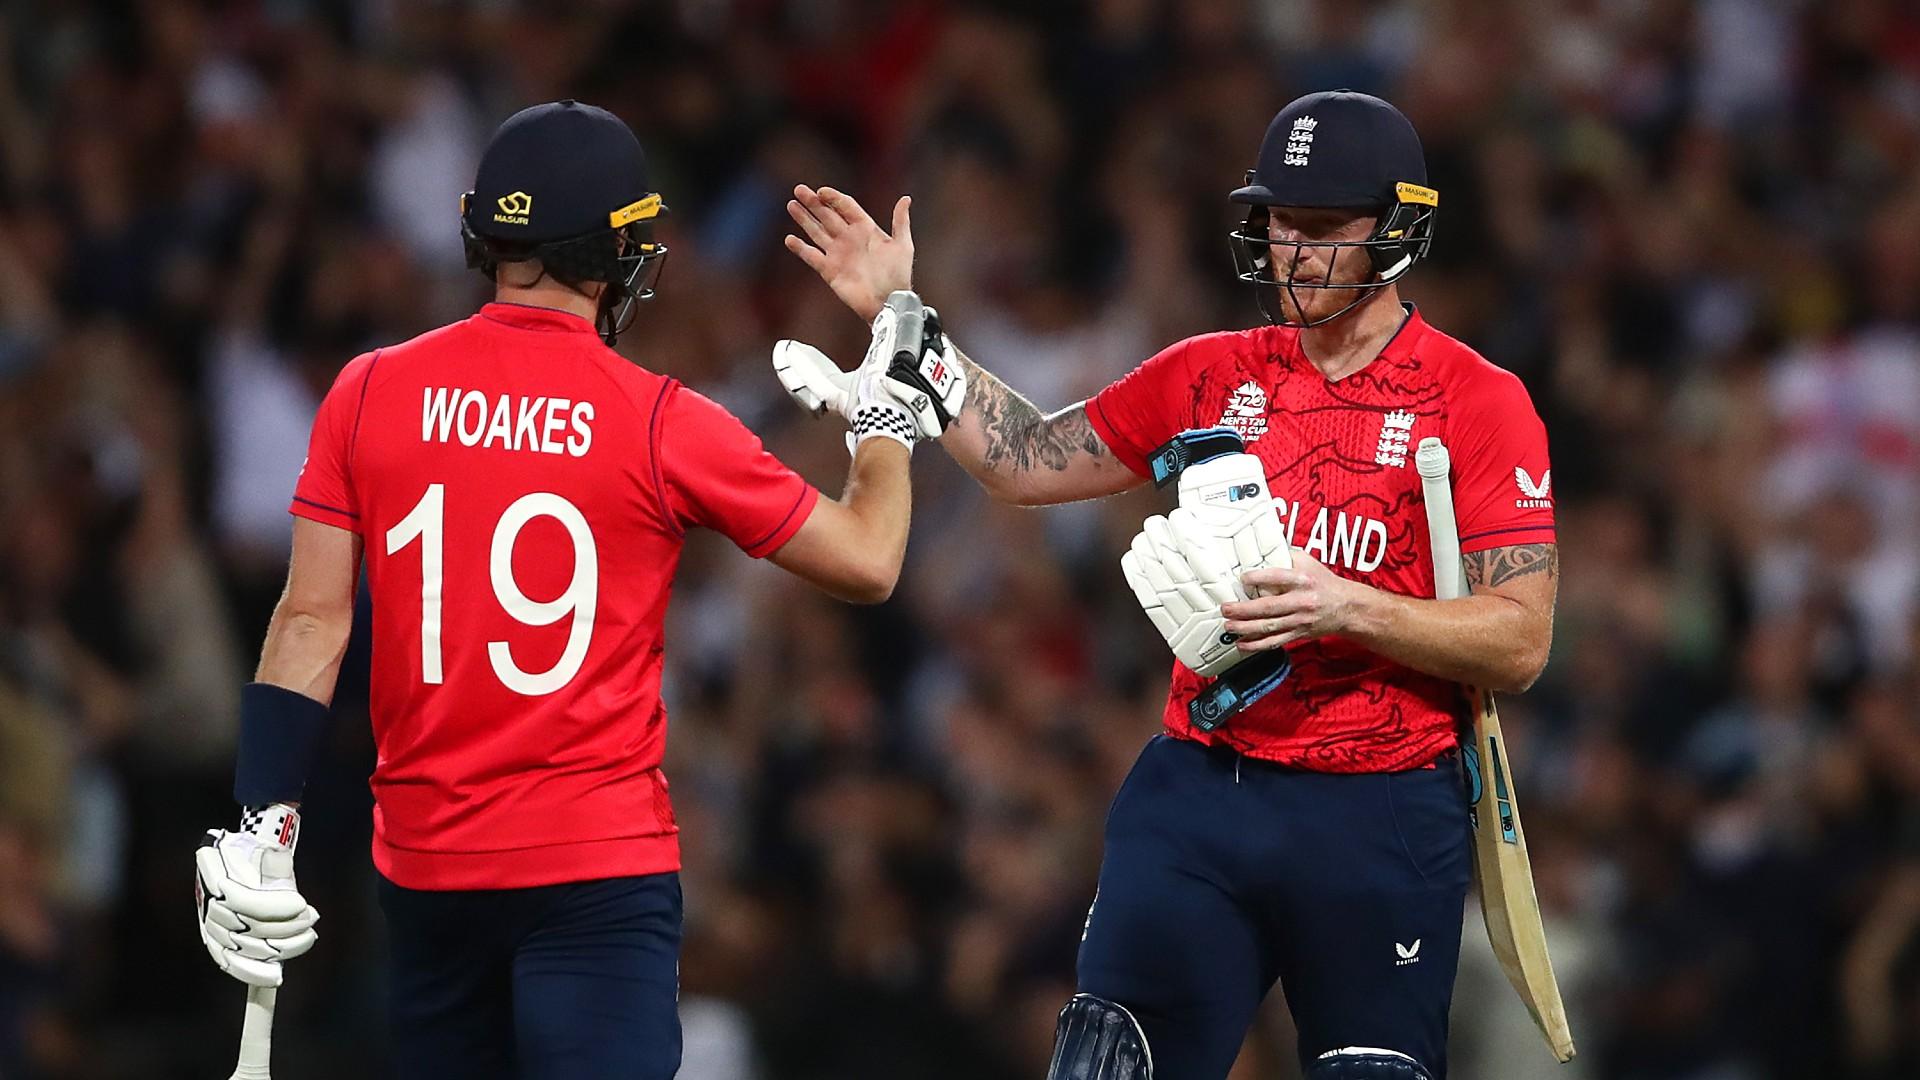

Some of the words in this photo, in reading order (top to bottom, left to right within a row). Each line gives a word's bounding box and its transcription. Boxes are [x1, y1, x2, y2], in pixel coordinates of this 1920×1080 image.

[493, 213, 529, 225] MASURI
[421, 386, 595, 458] WOAKES
[1248, 417, 1266, 426] T20
[1247, 426, 1268, 434] CUP
[386, 483, 599, 696] 19
